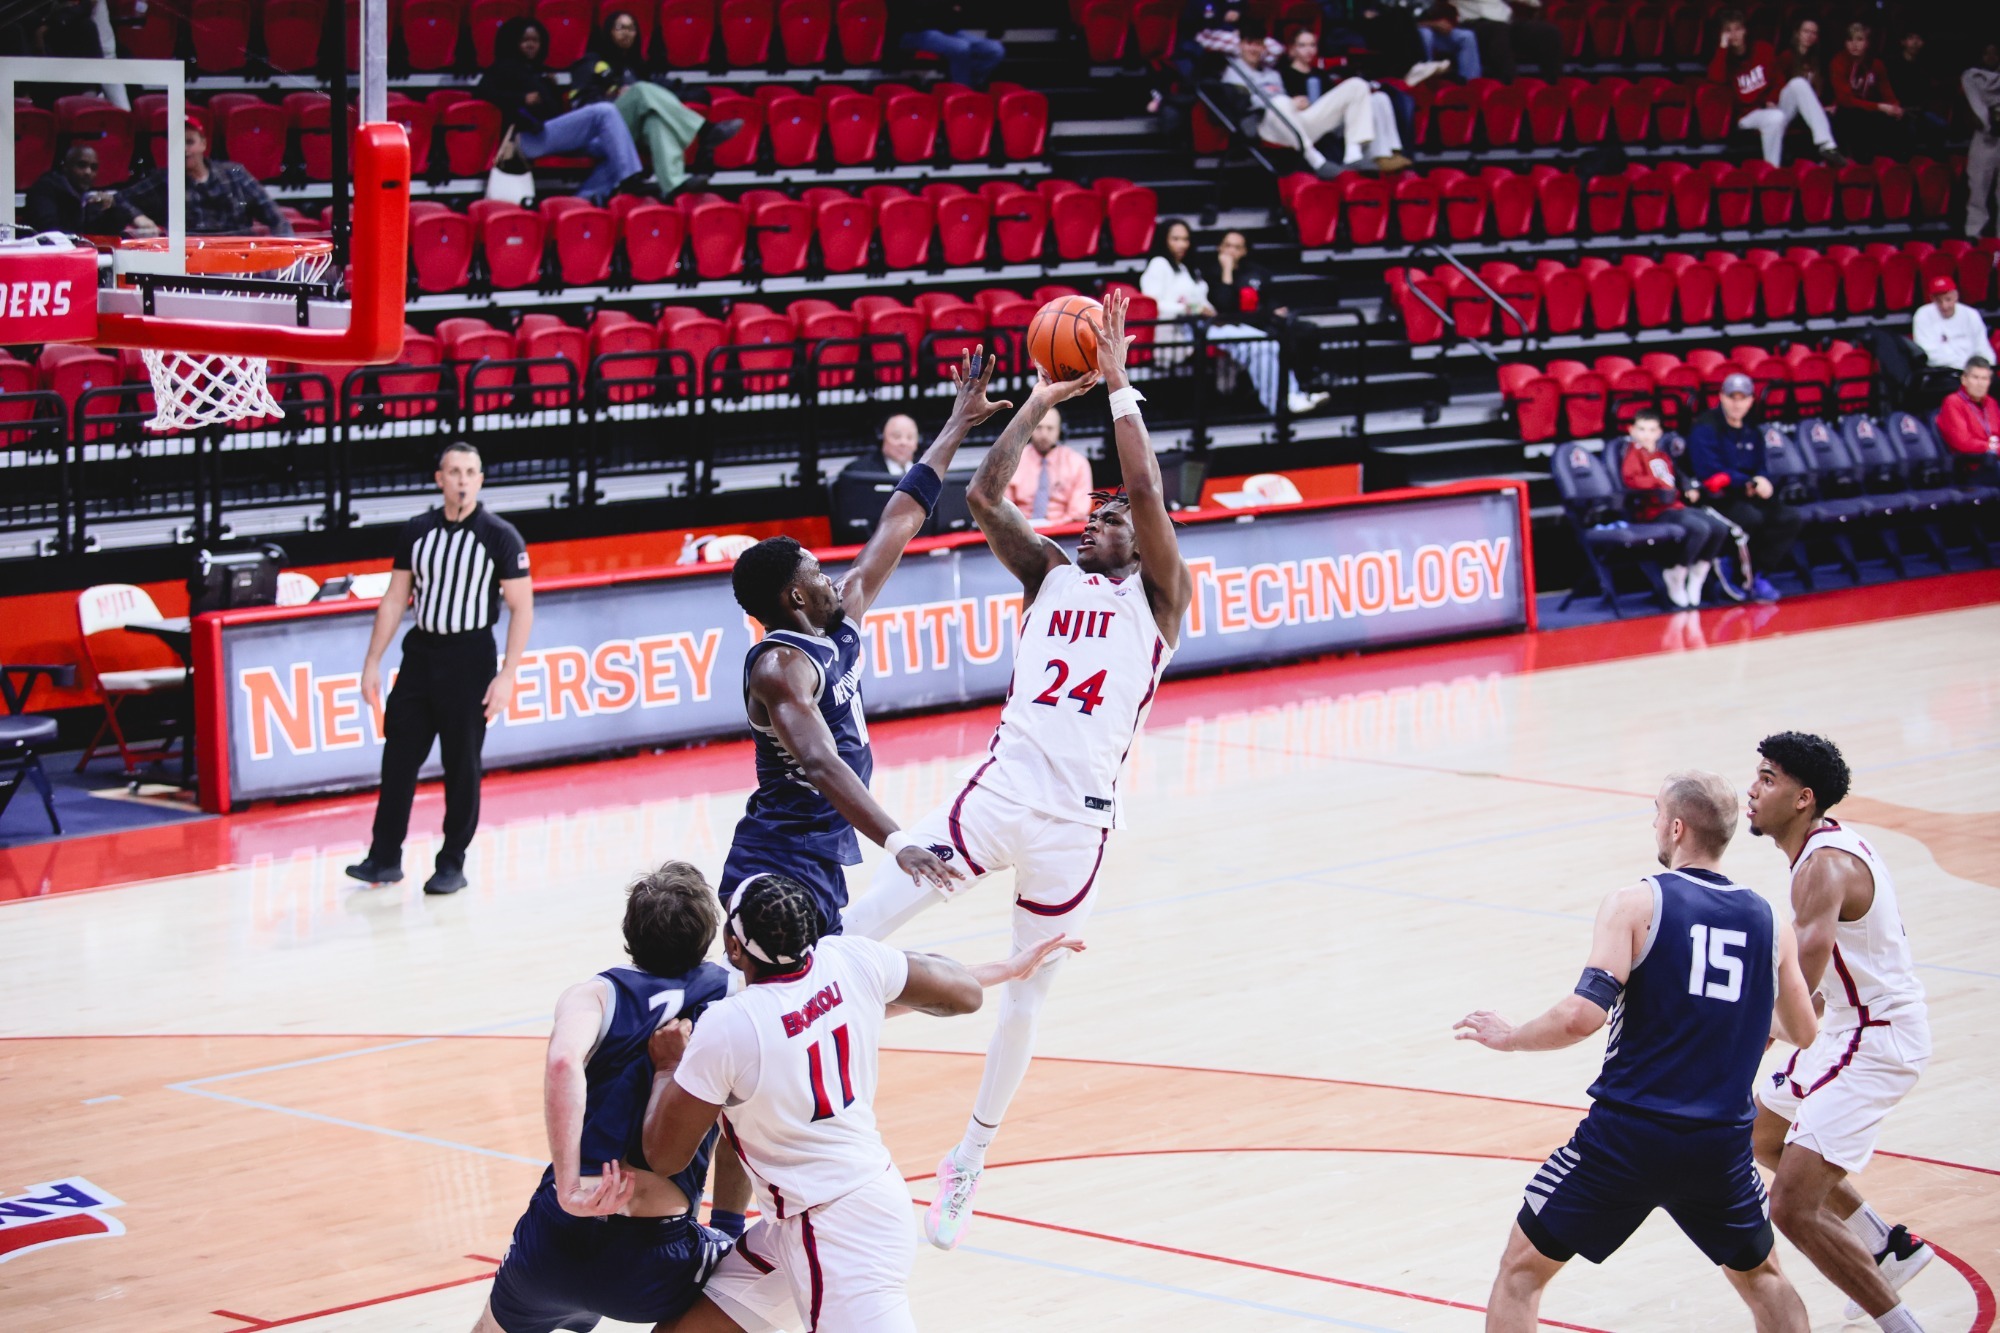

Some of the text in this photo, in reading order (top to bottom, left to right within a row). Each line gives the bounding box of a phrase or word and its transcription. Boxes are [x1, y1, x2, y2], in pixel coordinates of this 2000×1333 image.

[486, 628, 724, 728] ERSEY
[1186, 536, 1511, 638] TECHNOLOGY
[1047, 610, 1116, 645] NJIT
[1032, 658, 1108, 716] 24
[1688, 923, 1748, 1003] 15
[806, 1022, 856, 1123] 11
